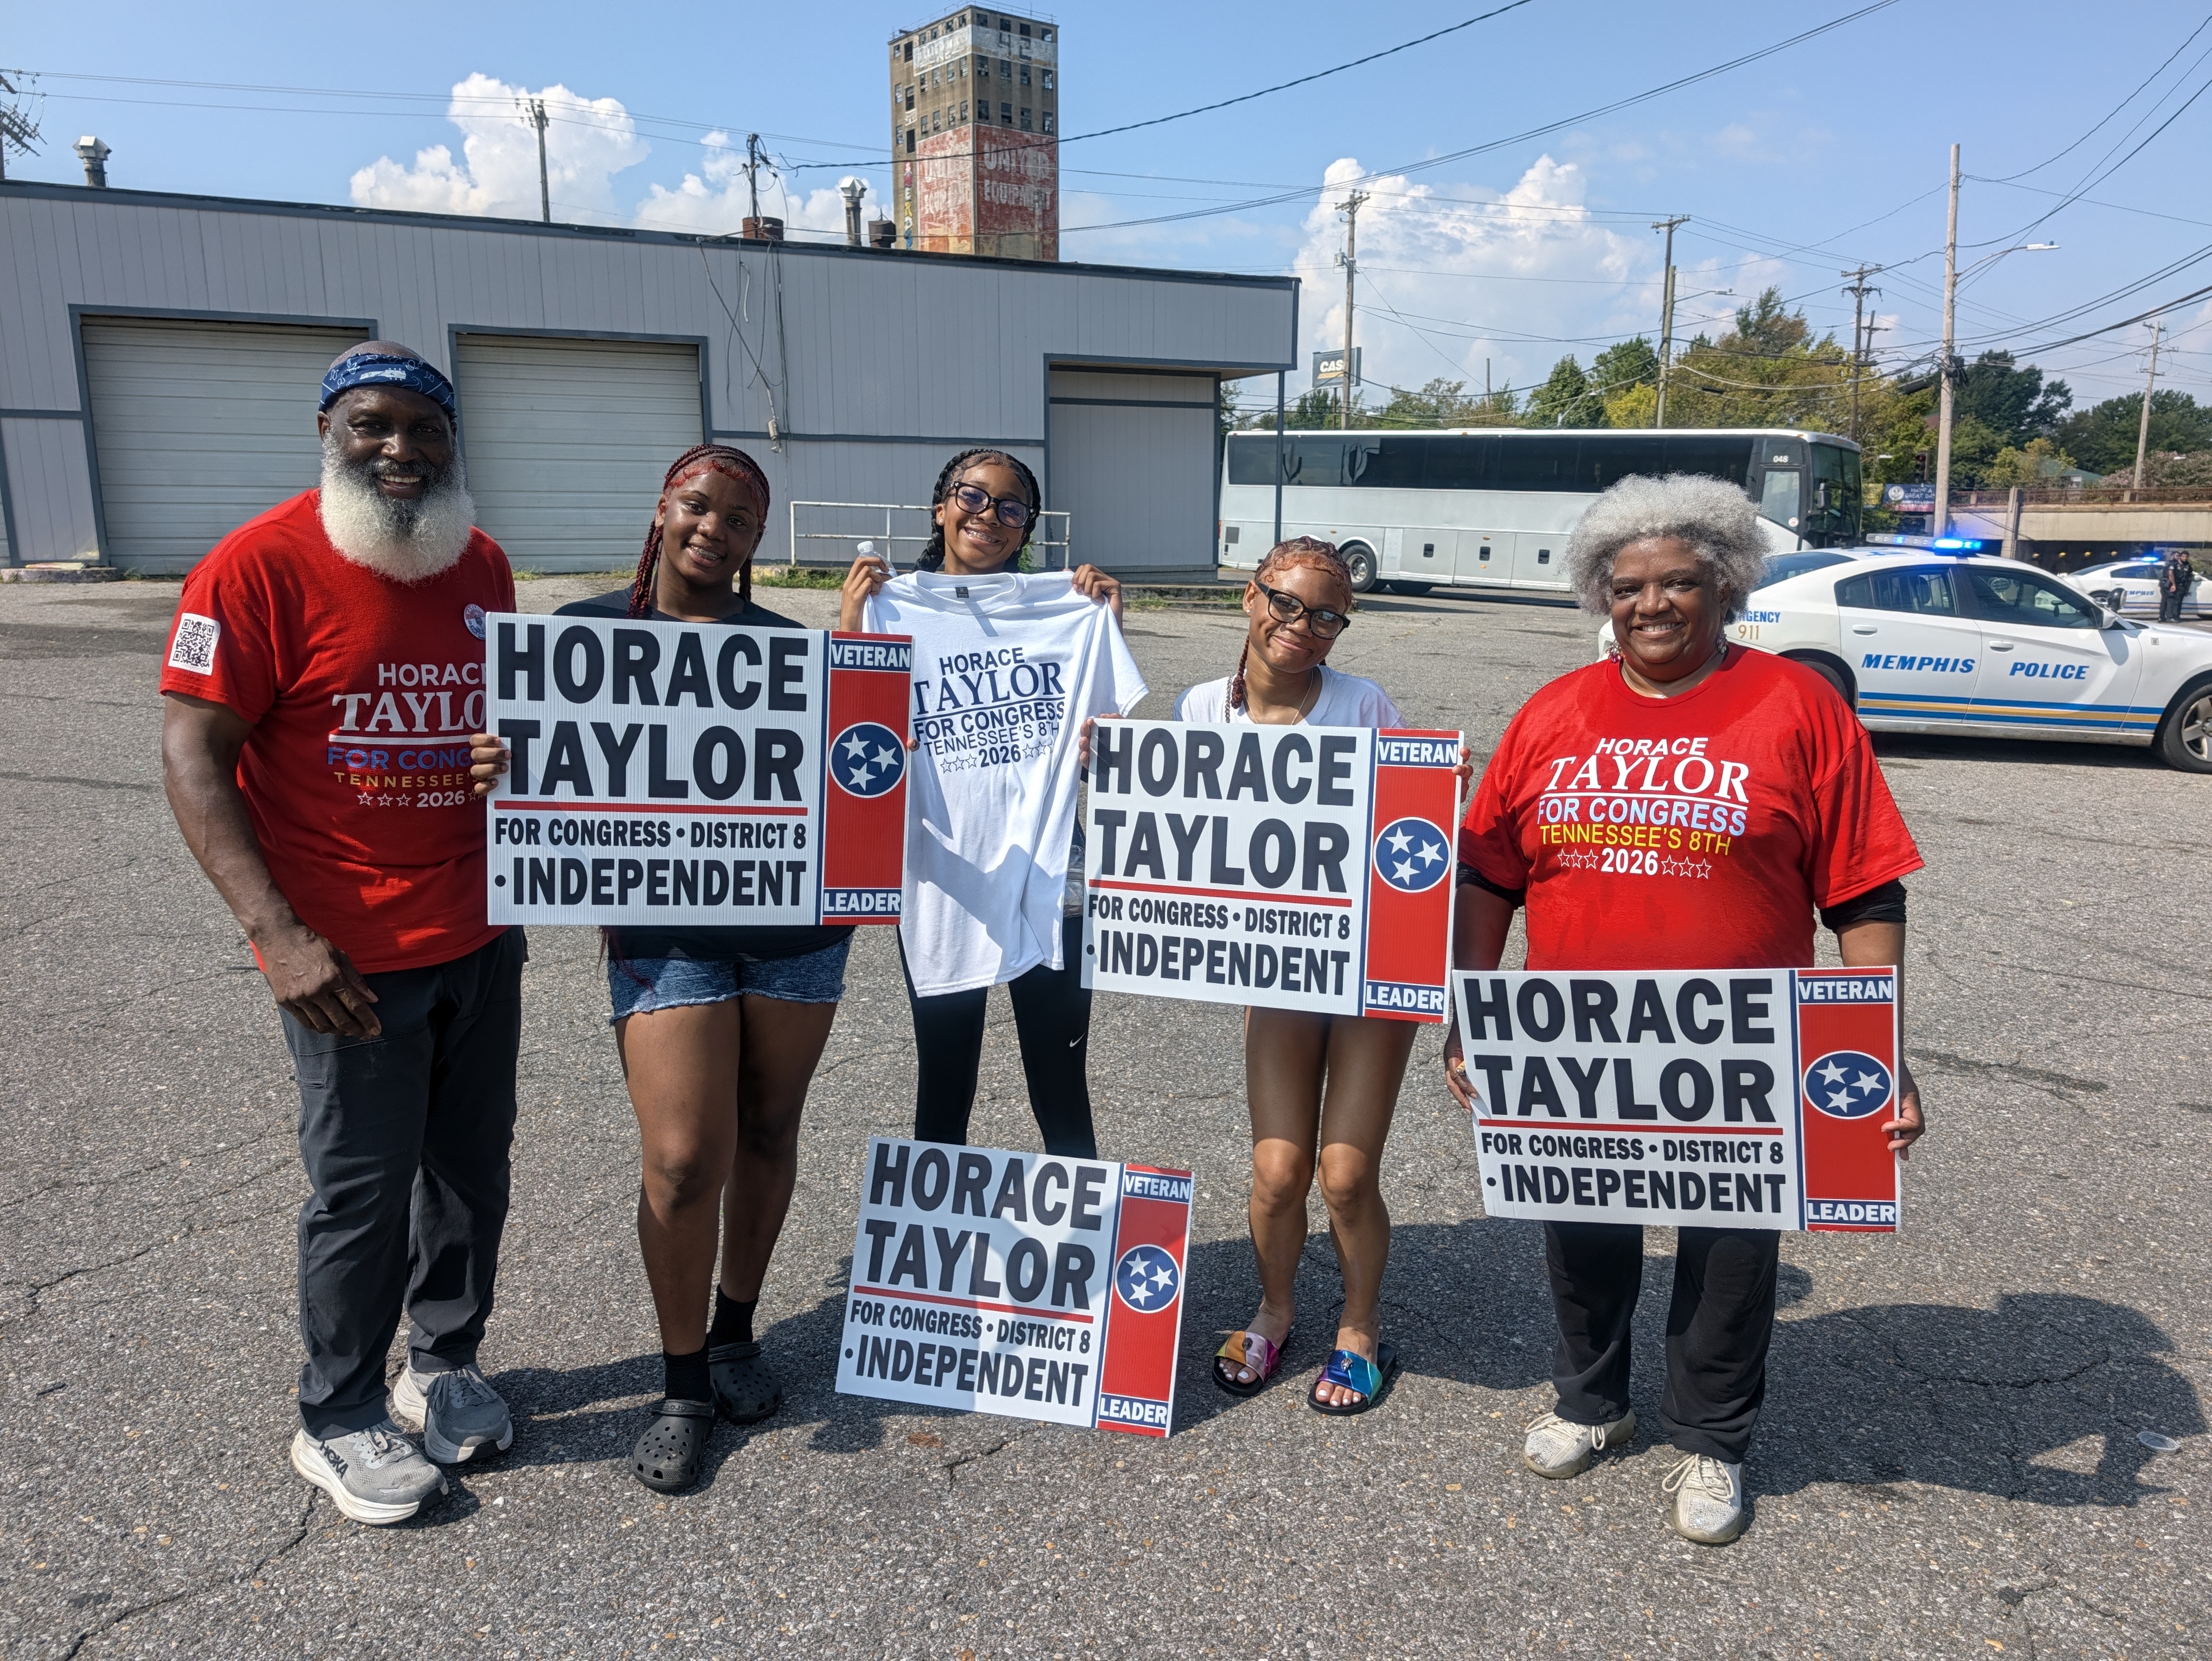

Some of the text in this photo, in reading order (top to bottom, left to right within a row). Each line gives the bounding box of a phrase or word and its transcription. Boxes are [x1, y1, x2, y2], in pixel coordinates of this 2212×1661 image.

[1320, 359, 1345, 372] CAS
[1738, 624, 1759, 640] 911
[498, 622, 808, 712] HORACE
[832, 644, 911, 668] VETERAN
[939, 647, 1025, 675] HORACE
[1861, 653, 2090, 680] MEMPHIS POLICE
[914, 662, 1065, 715] TAYLOR
[332, 689, 486, 732] TAYLO
[914, 701, 1064, 742] FOR CONGRESS
[924, 721, 1059, 757] TENNESSEE'S 8TH
[1379, 741, 1458, 764] VETERAN
[1596, 737, 1708, 756] HORACE
[327, 746, 389, 770] FOR
[498, 719, 803, 802] TAYLOR
[978, 744, 1021, 768] 2026
[1095, 726, 1356, 806] HORACE
[1545, 755, 1750, 803] TAYLOR
[416, 790, 466, 808] 2026
[1538, 797, 1747, 836] FOR CONGRESS
[495, 818, 806, 849] FOR CONGRESS DISTRICT 8
[1540, 824, 1732, 855] TENNESSEE'S 8TH
[1094, 808, 1349, 893] TAYLOR
[1600, 847, 1658, 875] 2026
[824, 892, 902, 913] LEADER
[1088, 894, 1351, 940] FOR CONGRESS DISTRICT 8
[1366, 984, 1444, 1010] LEADER
[1798, 979, 1893, 1000] VETERAN
[1463, 978, 1774, 1045] HORACE
[1474, 1054, 1776, 1123] TAYLOR
[1482, 1132, 1784, 1164] FOR CONGRESS DISTRICT 8
[869, 1143, 1107, 1231] HORACE
[1124, 1175, 1191, 1199] VETERAN
[1807, 1202, 1895, 1222] LEADER
[865, 1218, 1095, 1310] TAYLOR
[850, 1299, 1091, 1354] FOR CONGRESS DISTRICT 8
[1099, 1398, 1167, 1424] LEADER
[319, 1440, 349, 1480] HOKA
